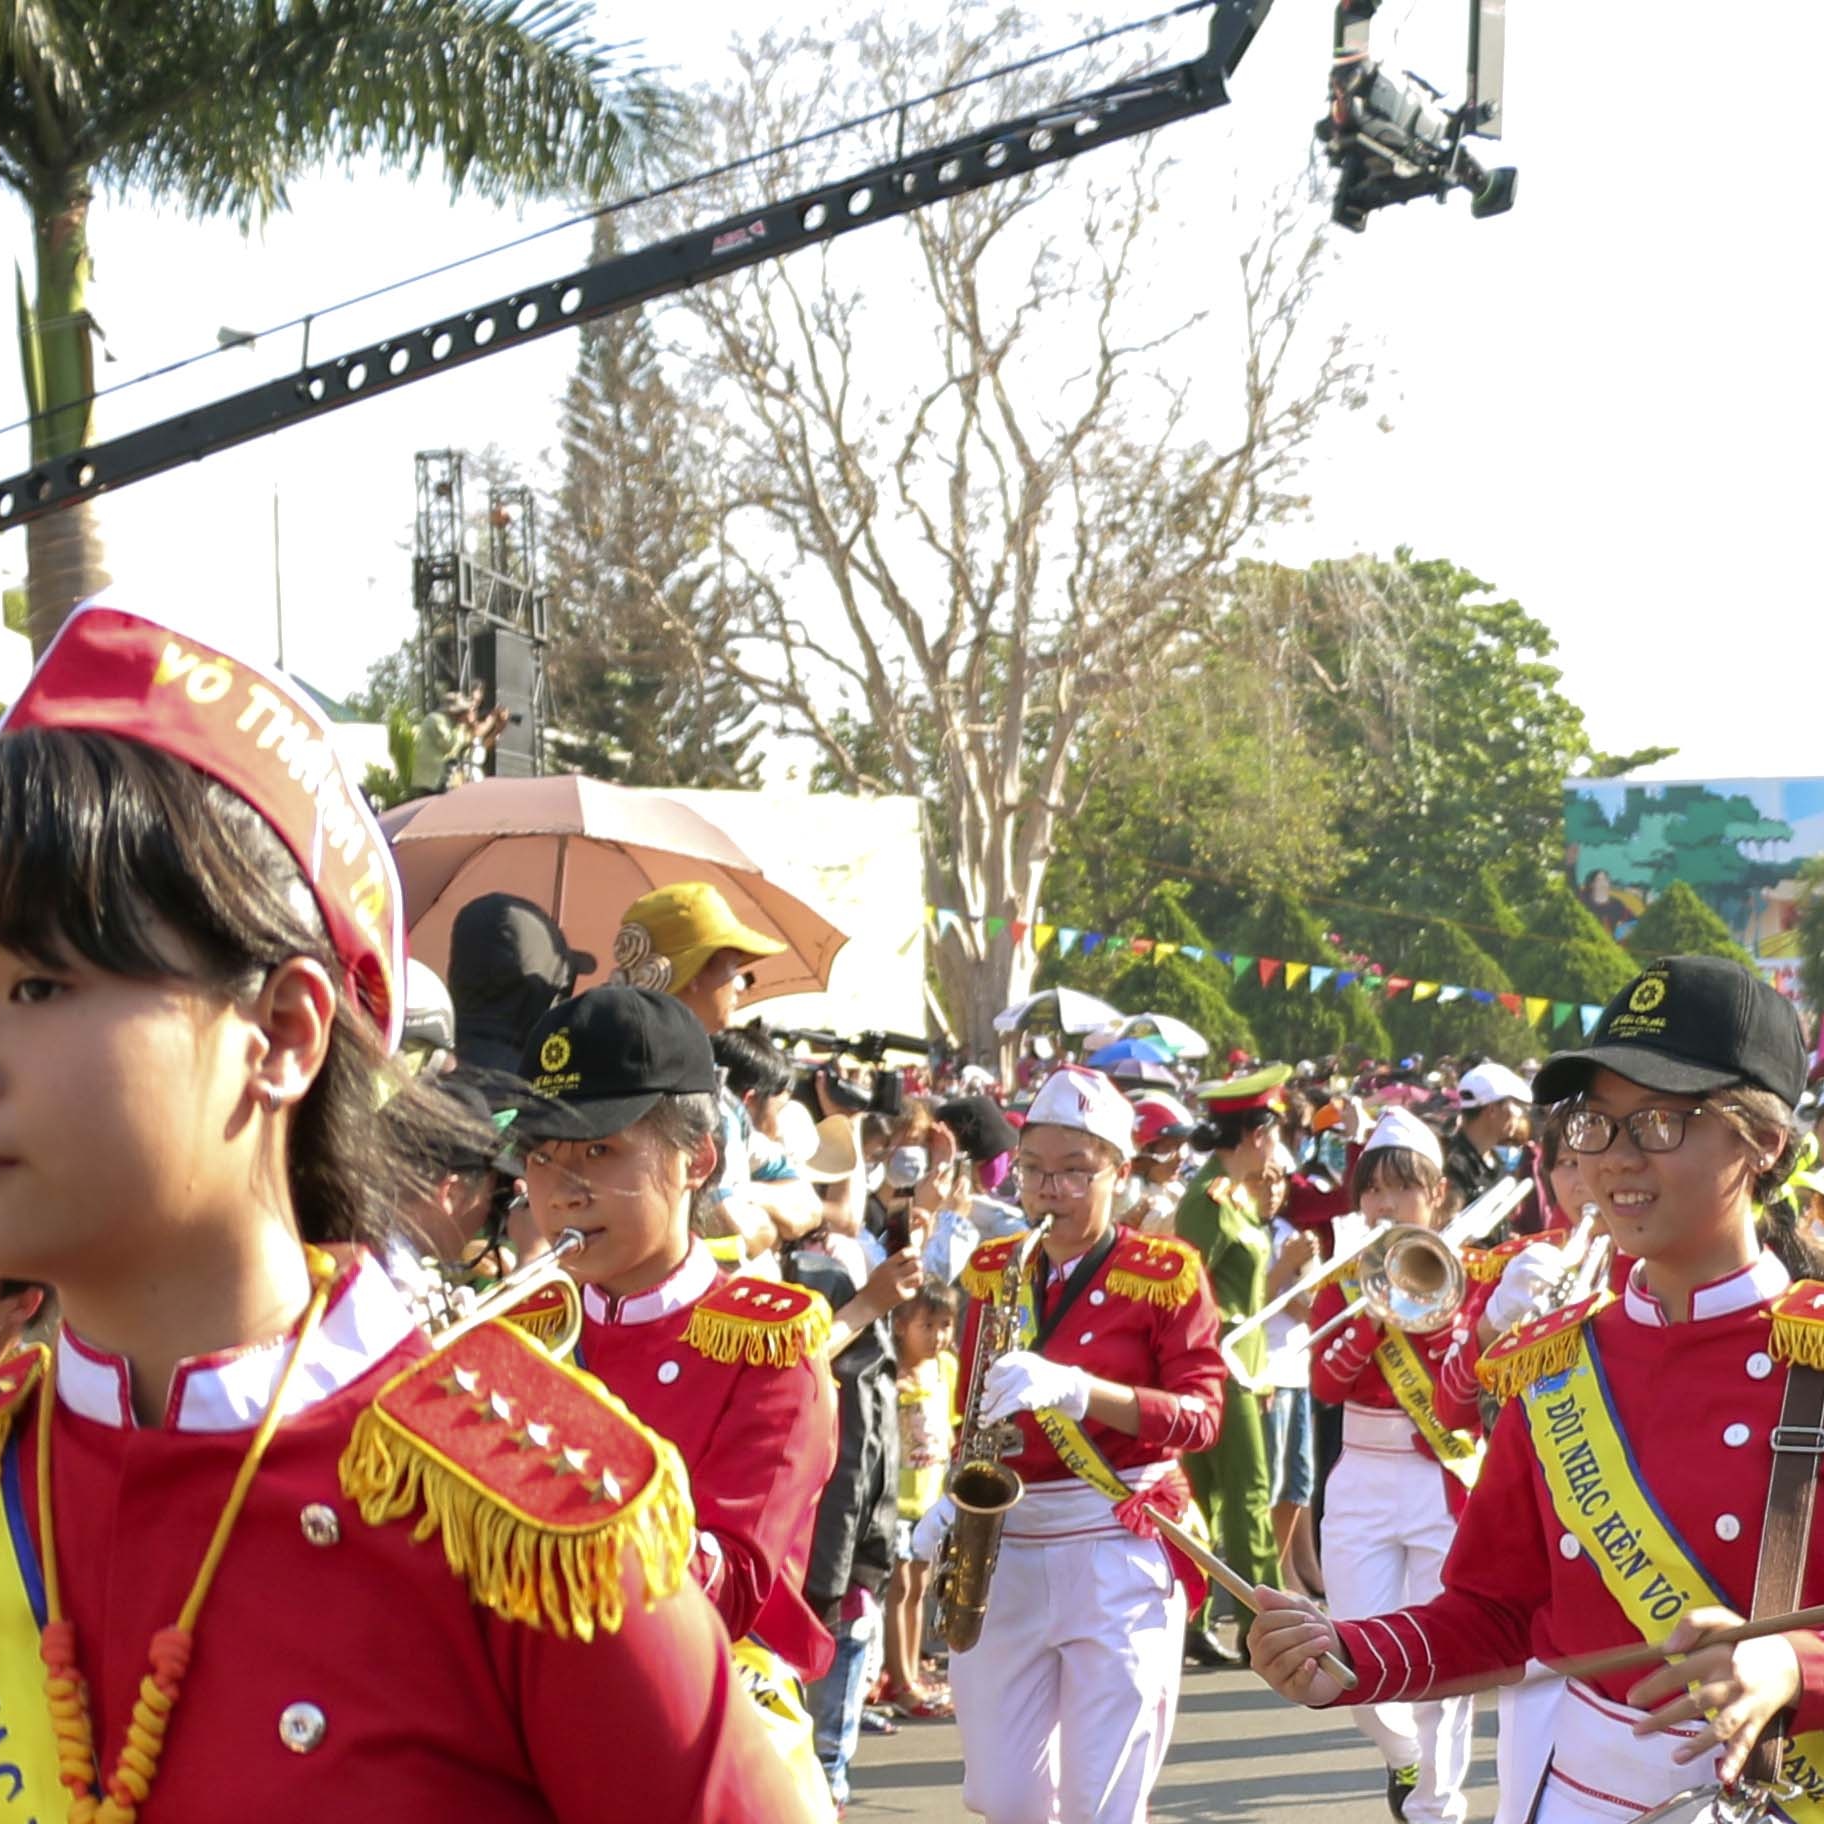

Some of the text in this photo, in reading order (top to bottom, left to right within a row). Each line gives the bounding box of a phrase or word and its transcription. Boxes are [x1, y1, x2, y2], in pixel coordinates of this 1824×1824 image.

[1544, 1393, 1691, 1622] ĐỘI NHẠC KÈN VÕ
